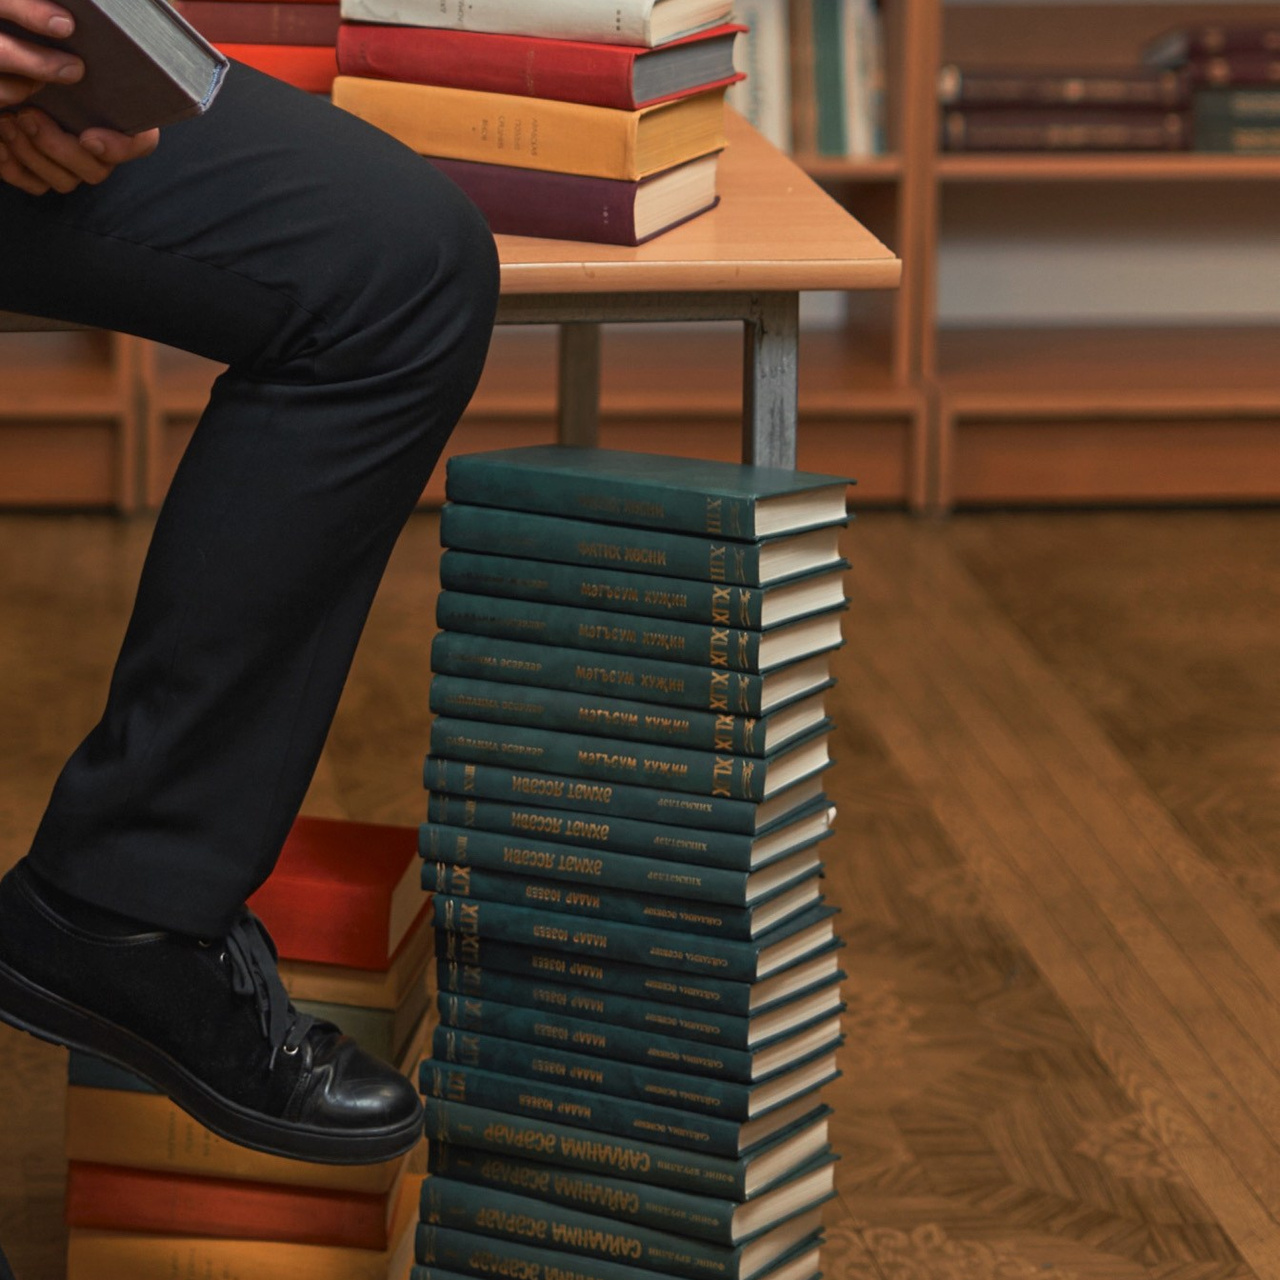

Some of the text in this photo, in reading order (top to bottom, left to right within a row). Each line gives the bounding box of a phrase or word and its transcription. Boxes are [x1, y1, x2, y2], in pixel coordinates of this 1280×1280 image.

[510, 774, 612, 803] ӘХМӘТ ЯССӘВИ
[509, 811, 610, 841] ӘХМӘТ ЯССӘВИ
[501, 846, 603, 876] ӘХМӘТ ЯССӘВИ
[481, 1120, 652, 1175] САЙЛАНМА ӘСӘРЛӘР
[478, 1157, 642, 1216] САЙЛАНМА ӘСӘРЛӘР
[474, 1205, 644, 1261] САЙЛАНМА ӘСӘРЛӘР
